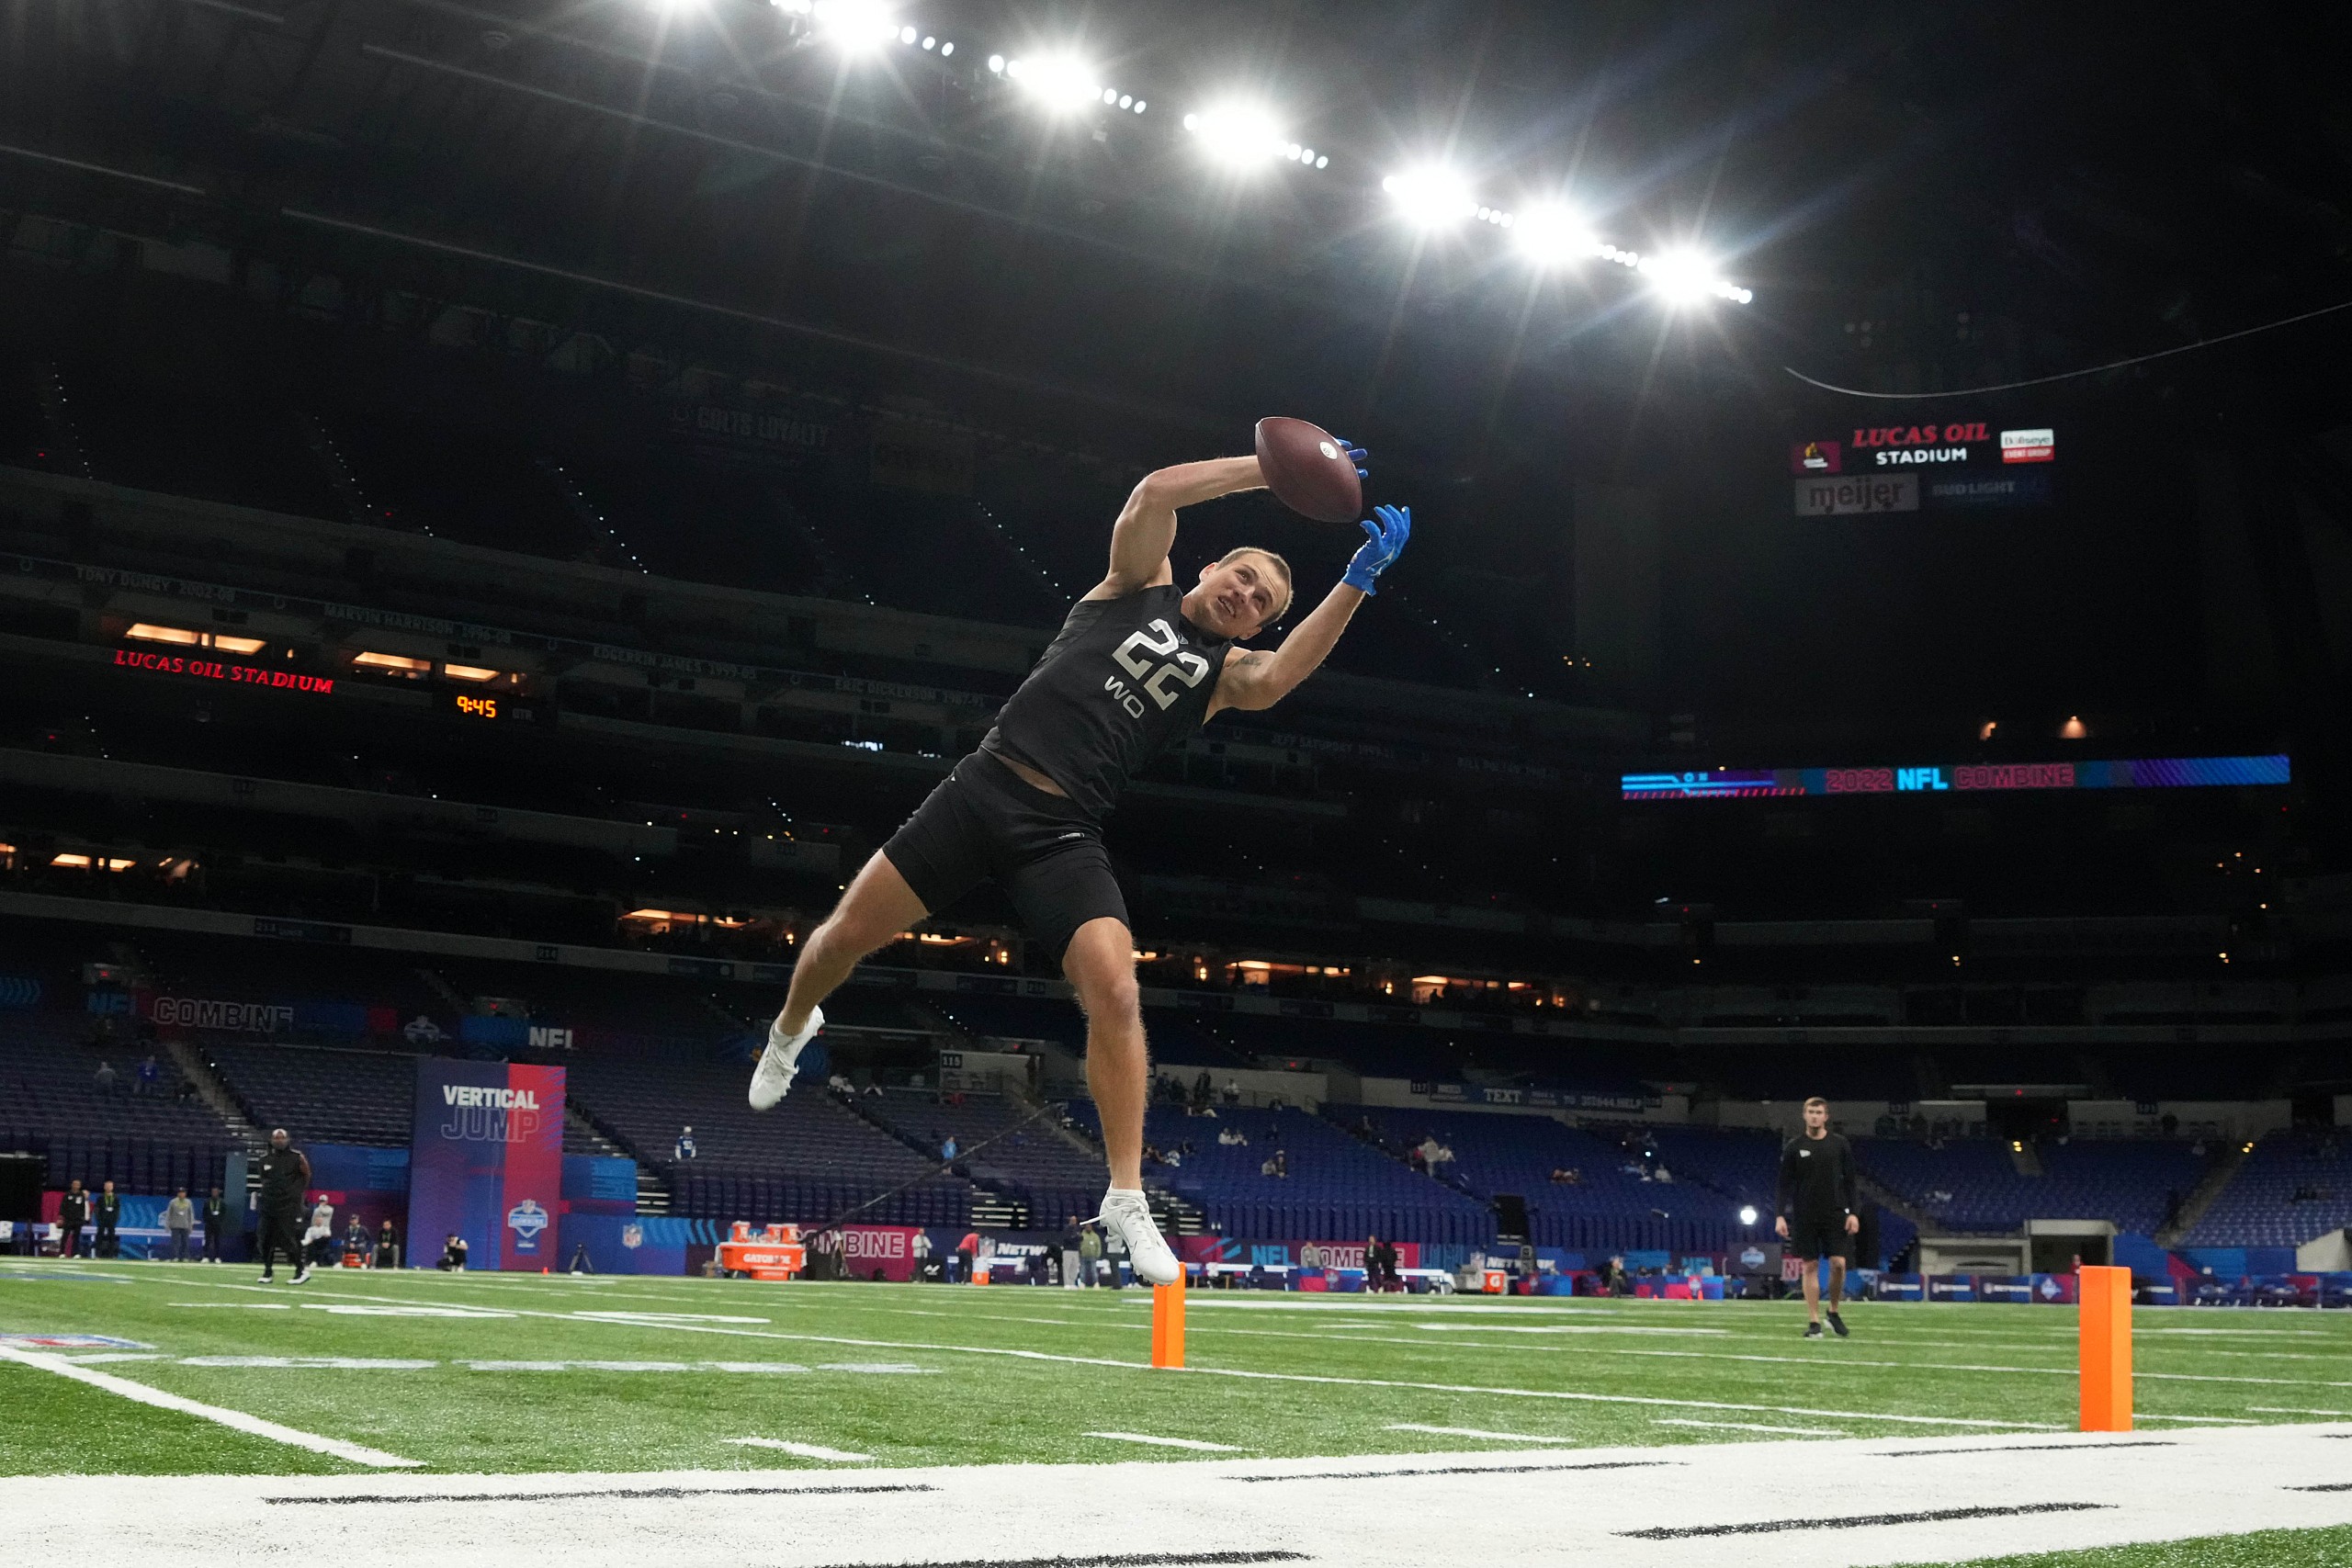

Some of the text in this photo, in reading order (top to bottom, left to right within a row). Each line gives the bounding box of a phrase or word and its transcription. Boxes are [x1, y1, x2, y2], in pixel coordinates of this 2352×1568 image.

[1852, 423, 1990, 448] LUCAS OIL
[1876, 447, 1967, 466] STADIUM
[1809, 480, 1905, 513] meijer
[1969, 479, 2016, 497] LIGHT
[114, 649, 334, 694] LUCAS OIL STADIUM
[1112, 618, 1209, 711] 22
[457, 695, 497, 718] 9:45
[1104, 675, 1145, 719] WO
[1826, 763, 2075, 792] 2022 NFL COMBINE
[443, 1085, 539, 1110] VERTICAL
[1483, 1088, 1522, 1103] TEXT
[441, 1106, 540, 1143] JUMP
[797, 1229, 905, 1258] OMBINE
[997, 1242, 1048, 1257] NETW
[1250, 1245, 1297, 1267] NFL
